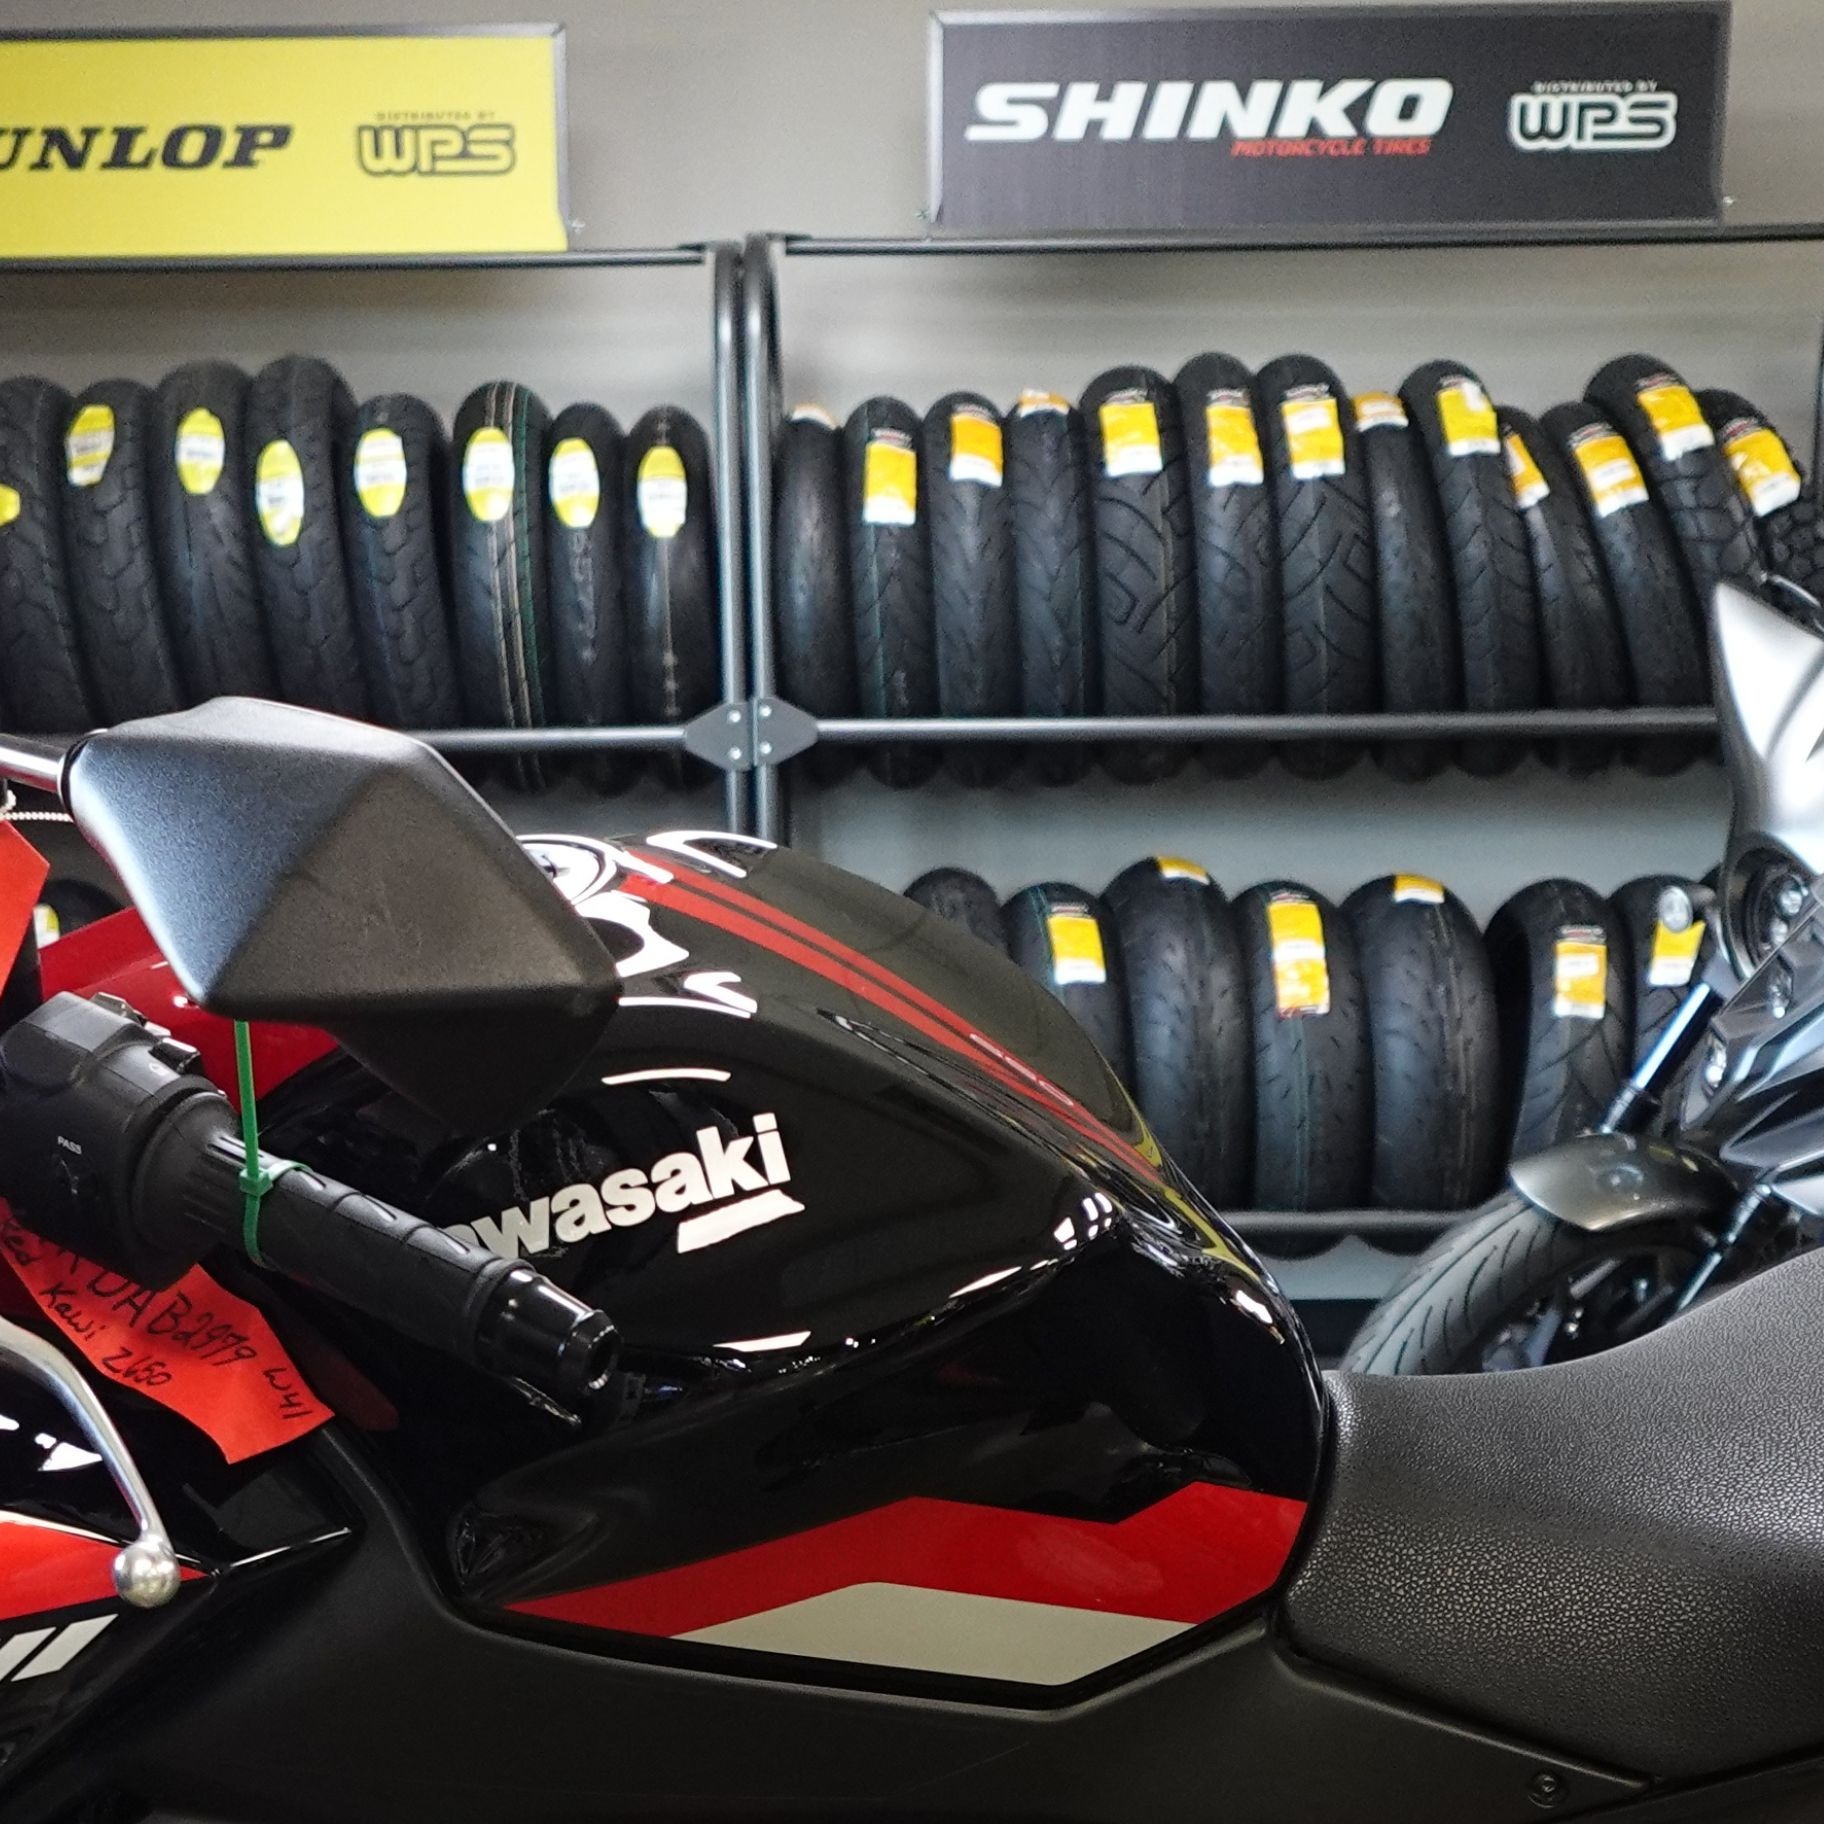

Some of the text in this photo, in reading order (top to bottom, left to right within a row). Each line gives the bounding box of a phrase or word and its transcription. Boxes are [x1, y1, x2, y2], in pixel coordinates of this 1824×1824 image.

[964, 78, 1455, 142] SHINKO
[1530, 78, 1658, 93] DISTRIBUTED BY
[1230, 136, 1431, 159] MOTORCYCLE TIRES
[1510, 91, 1678, 150] WPS
[356, 122, 516, 177] WPS
[57, 1135, 82, 1155] PASS
[446, 1112, 792, 1260] wasaki
